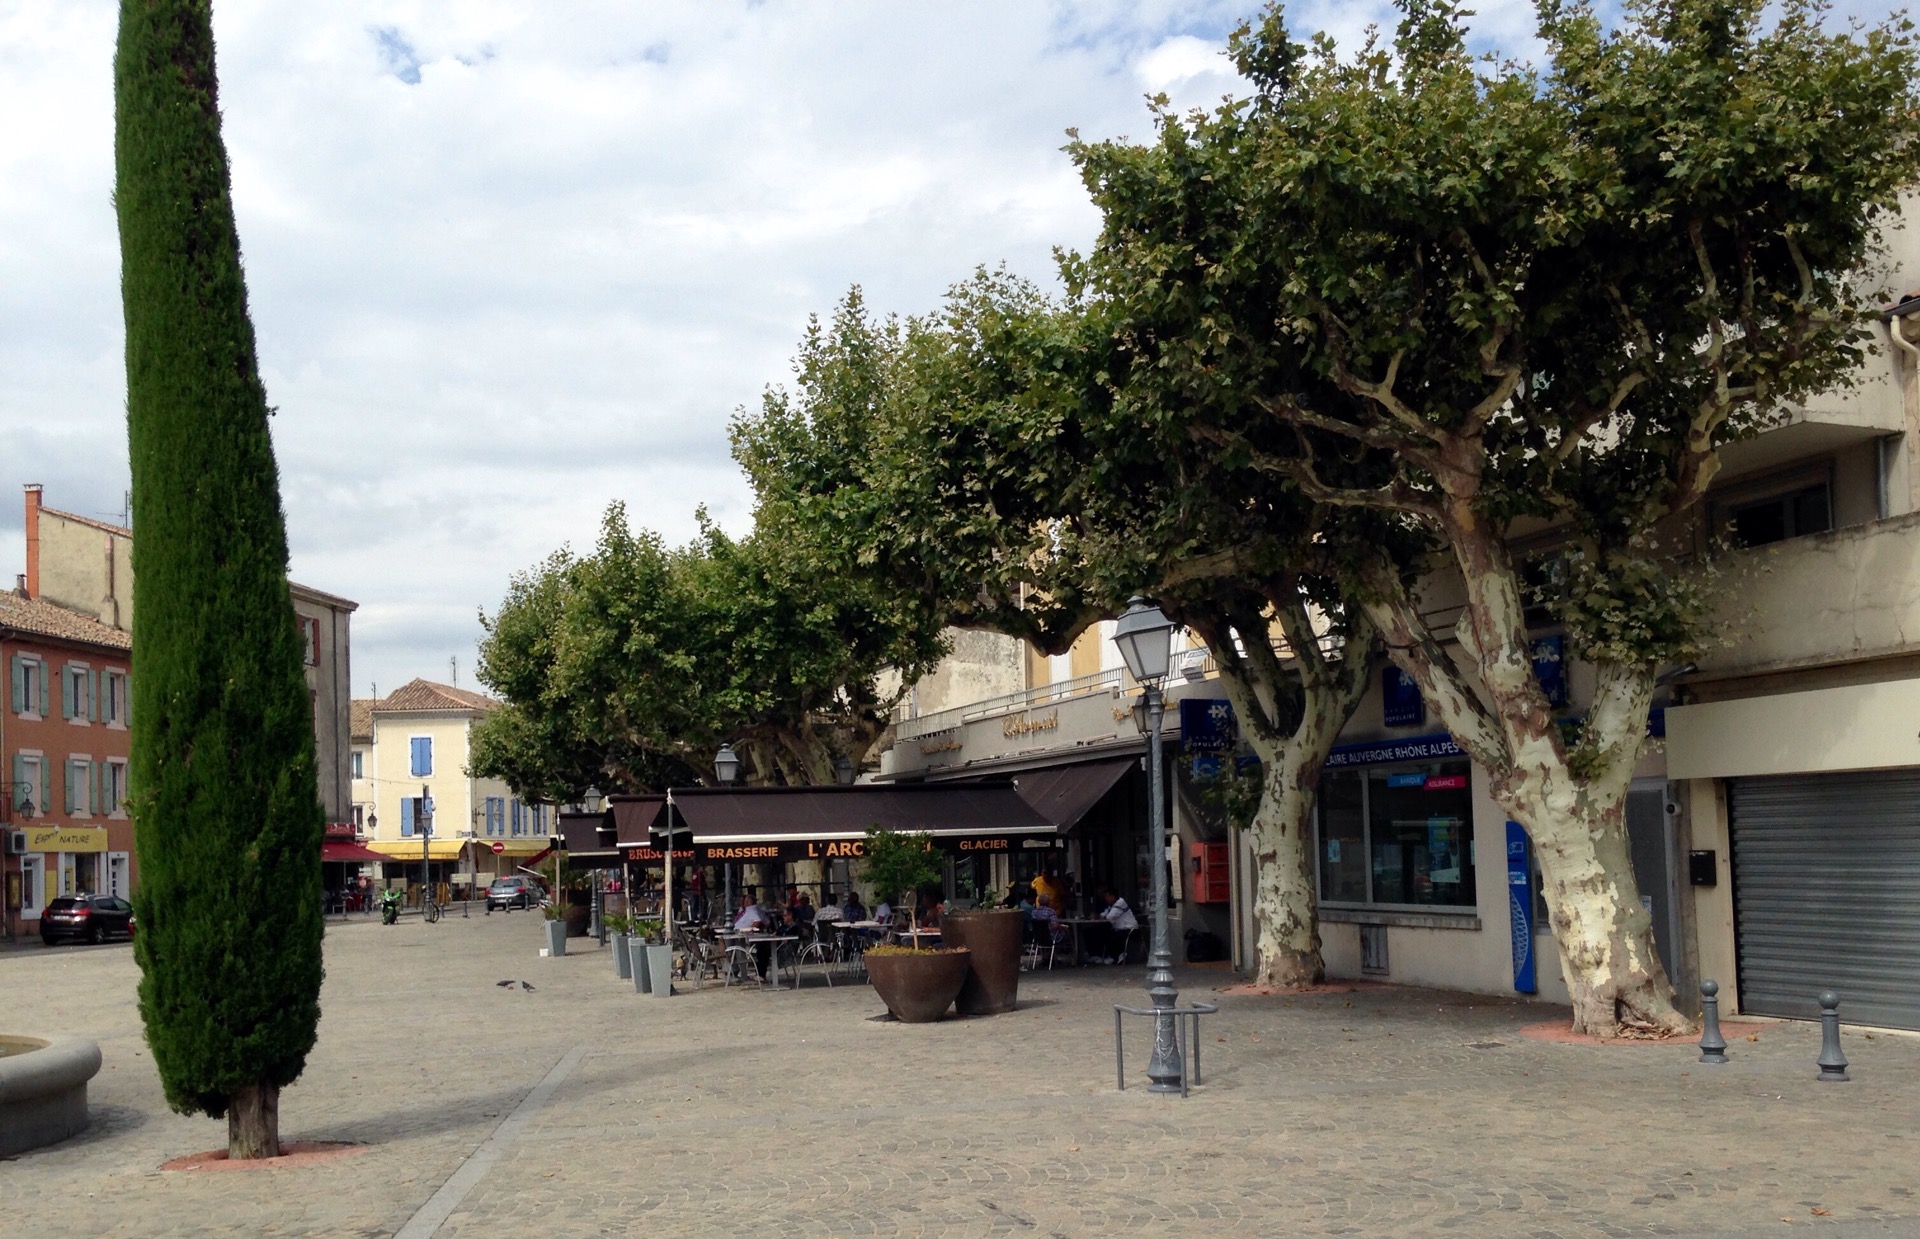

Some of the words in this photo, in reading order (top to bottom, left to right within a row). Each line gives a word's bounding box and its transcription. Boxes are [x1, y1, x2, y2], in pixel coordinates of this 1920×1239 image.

[1350, 748, 1394, 763] AUVERGNE
[1395, 743, 1429, 759] RHÔNE
[1430, 741, 1460, 755] ALPES
[59, 834, 91, 844] NATURE
[959, 839, 1008, 850] GLACIER
[707, 846, 779, 859] BRASSERIE
